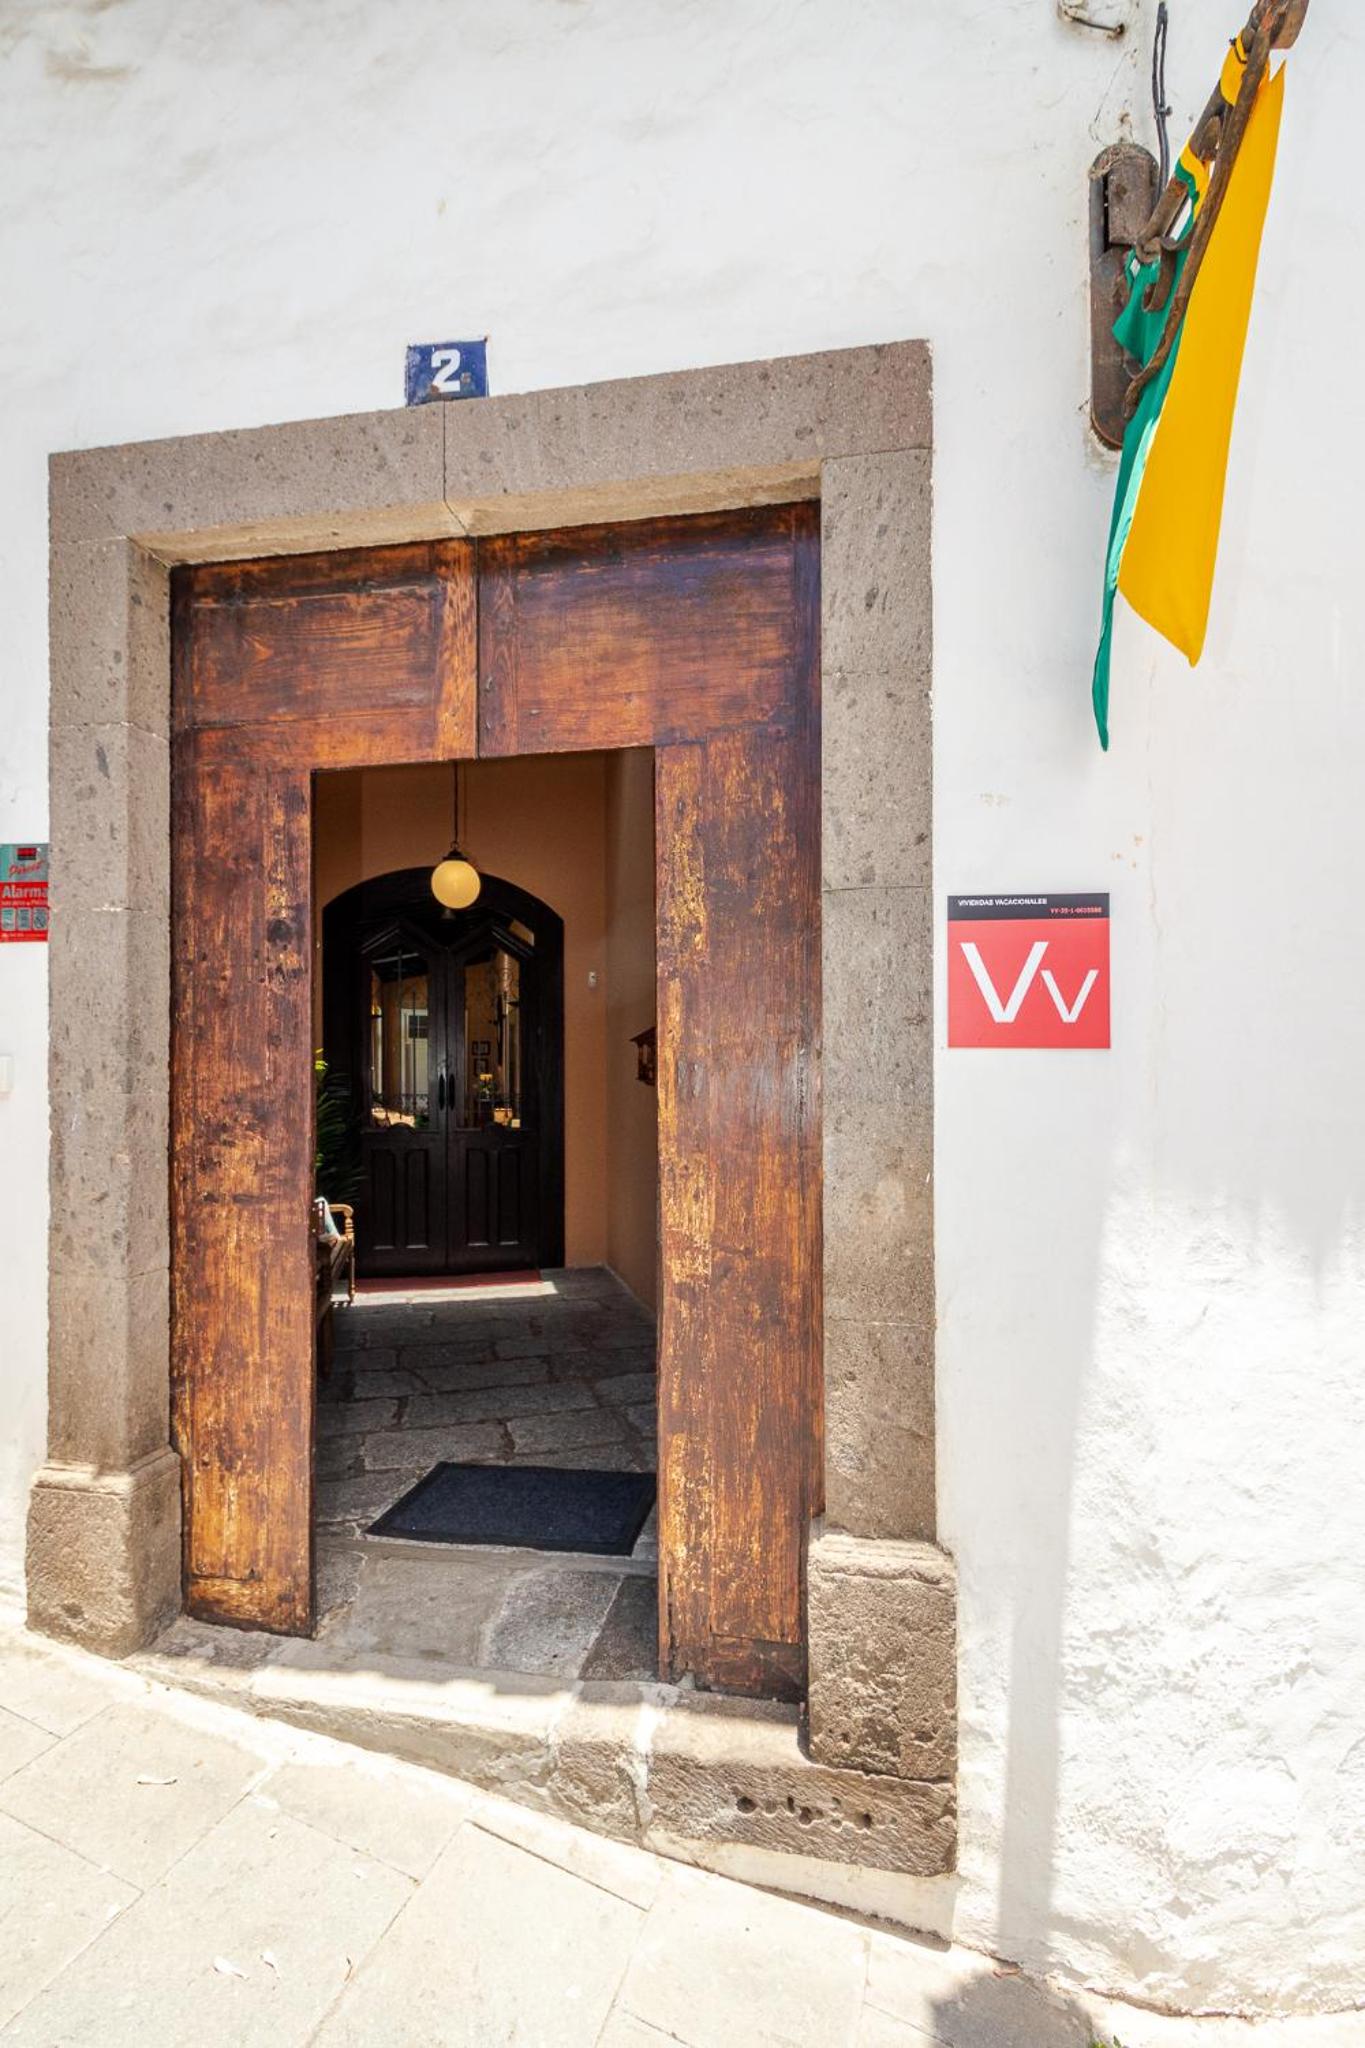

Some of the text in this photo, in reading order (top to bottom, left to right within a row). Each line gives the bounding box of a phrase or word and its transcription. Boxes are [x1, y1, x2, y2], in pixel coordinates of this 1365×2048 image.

[431, 349, 461, 393] 2
[958, 897, 1048, 907] VIVIENDAS VACACIONALES
